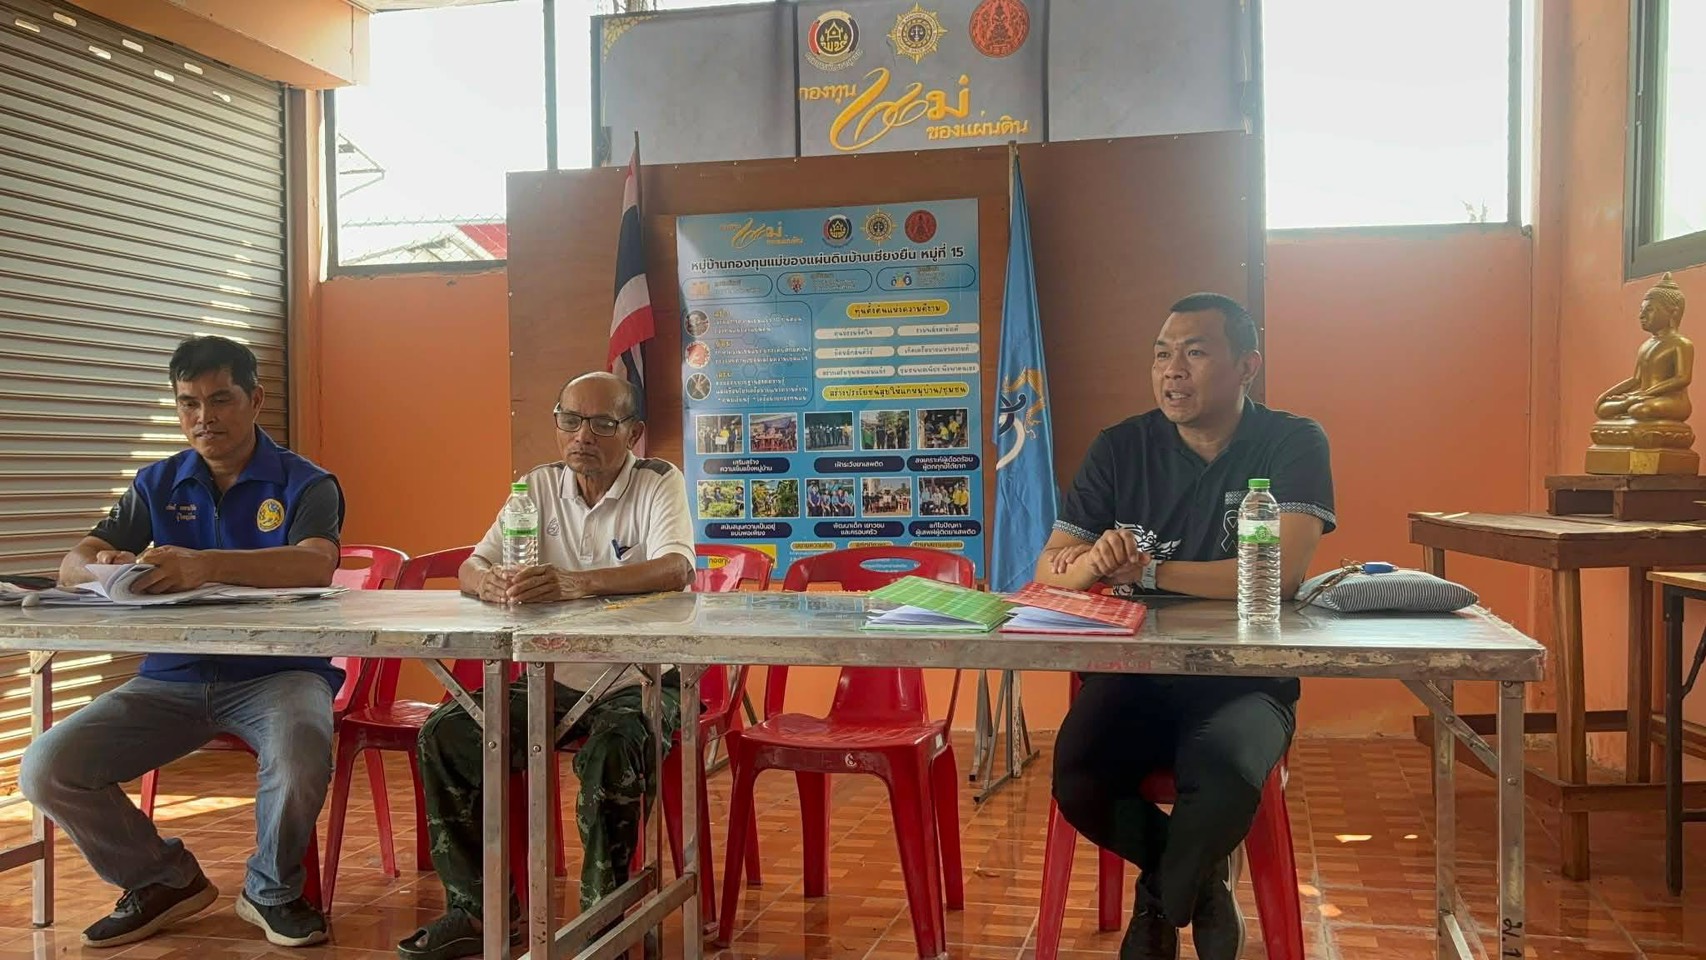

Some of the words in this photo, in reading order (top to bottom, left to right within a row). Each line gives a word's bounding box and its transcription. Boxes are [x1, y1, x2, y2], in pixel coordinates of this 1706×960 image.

[798, 82, 857, 105] กองทุน
[926, 110, 1029, 141] ของแผ่นดิน
[691, 250, 916, 273] หมู่บ้านกองทุนแม่ของแผ่นดินบ้านเชียงยืน
[921, 245, 948, 262] หมู่ที่
[951, 246, 964, 258] 15
